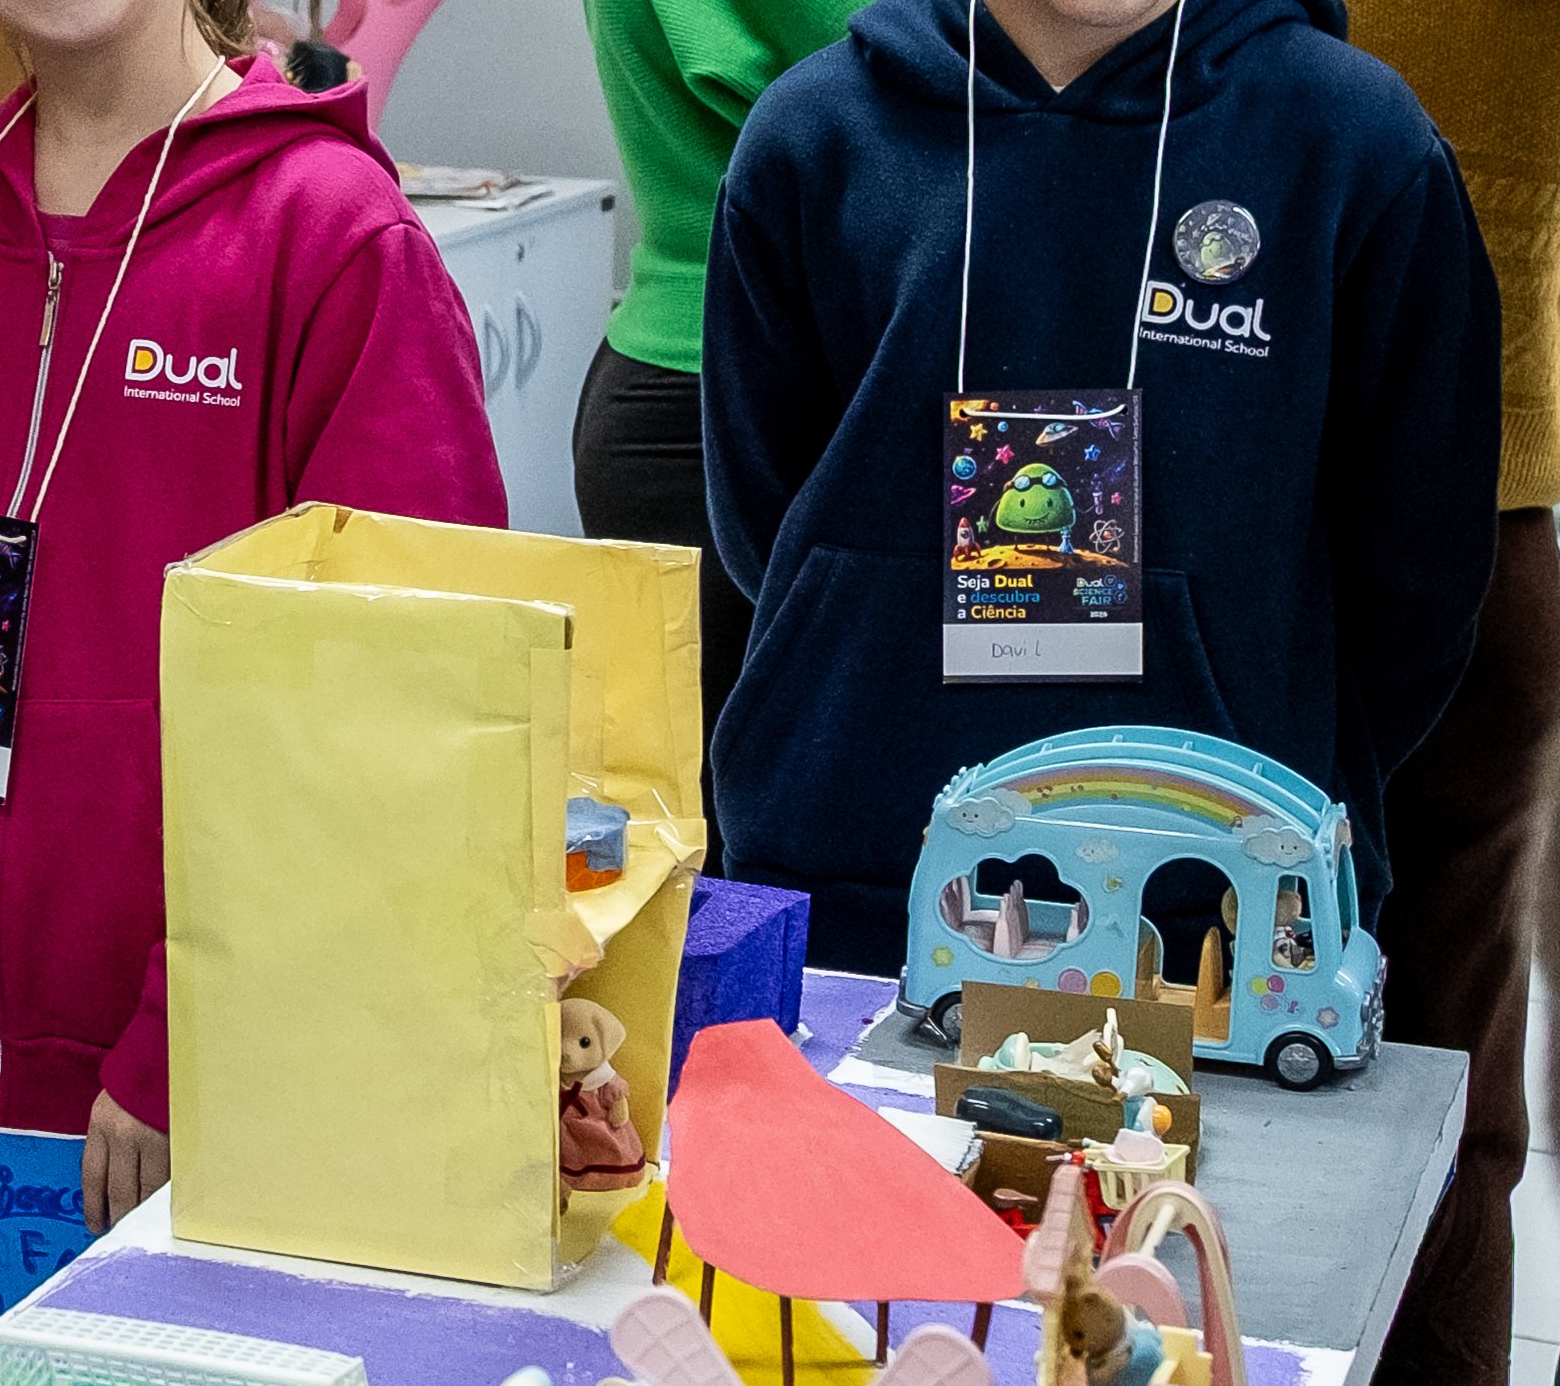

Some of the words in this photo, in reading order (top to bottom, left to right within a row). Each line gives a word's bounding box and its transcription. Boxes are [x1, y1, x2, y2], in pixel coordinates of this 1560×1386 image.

[1141, 280, 1271, 341] Dual
[1139, 327, 1222, 350] International
[1225, 340, 1269, 358] School
[125, 339, 242, 390] Dual
[124, 386, 200, 402] International
[202, 392, 241, 407] School
[957, 575, 990, 591] Seja
[994, 574, 1033, 588] Dual
[957, 593, 966, 603] e
[971, 590, 1040, 603] descubra
[1082, 596, 1112, 606] FAIR
[957, 609, 966, 619] a
[971, 605, 1027, 619] Ciência
